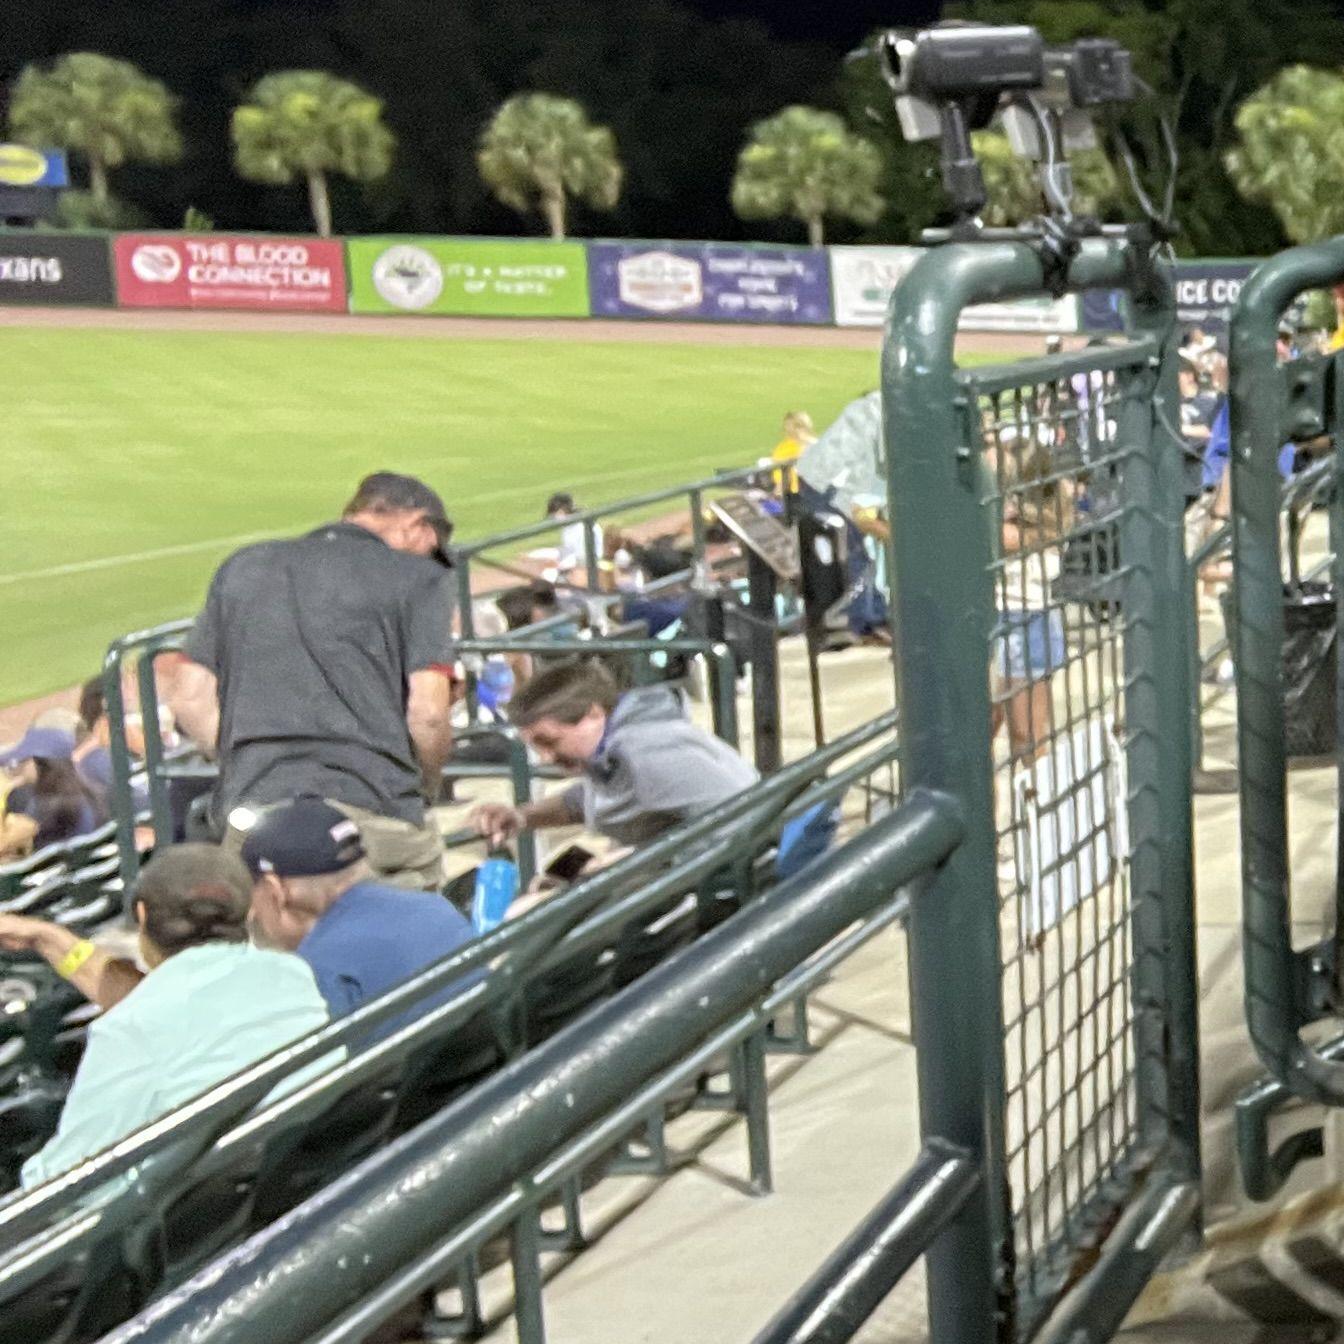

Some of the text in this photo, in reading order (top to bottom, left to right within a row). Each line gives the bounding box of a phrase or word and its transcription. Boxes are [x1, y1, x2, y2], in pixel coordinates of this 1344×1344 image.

[185, 241, 309, 266] THE BLOOD
[188, 264, 331, 288] CONNECTION
